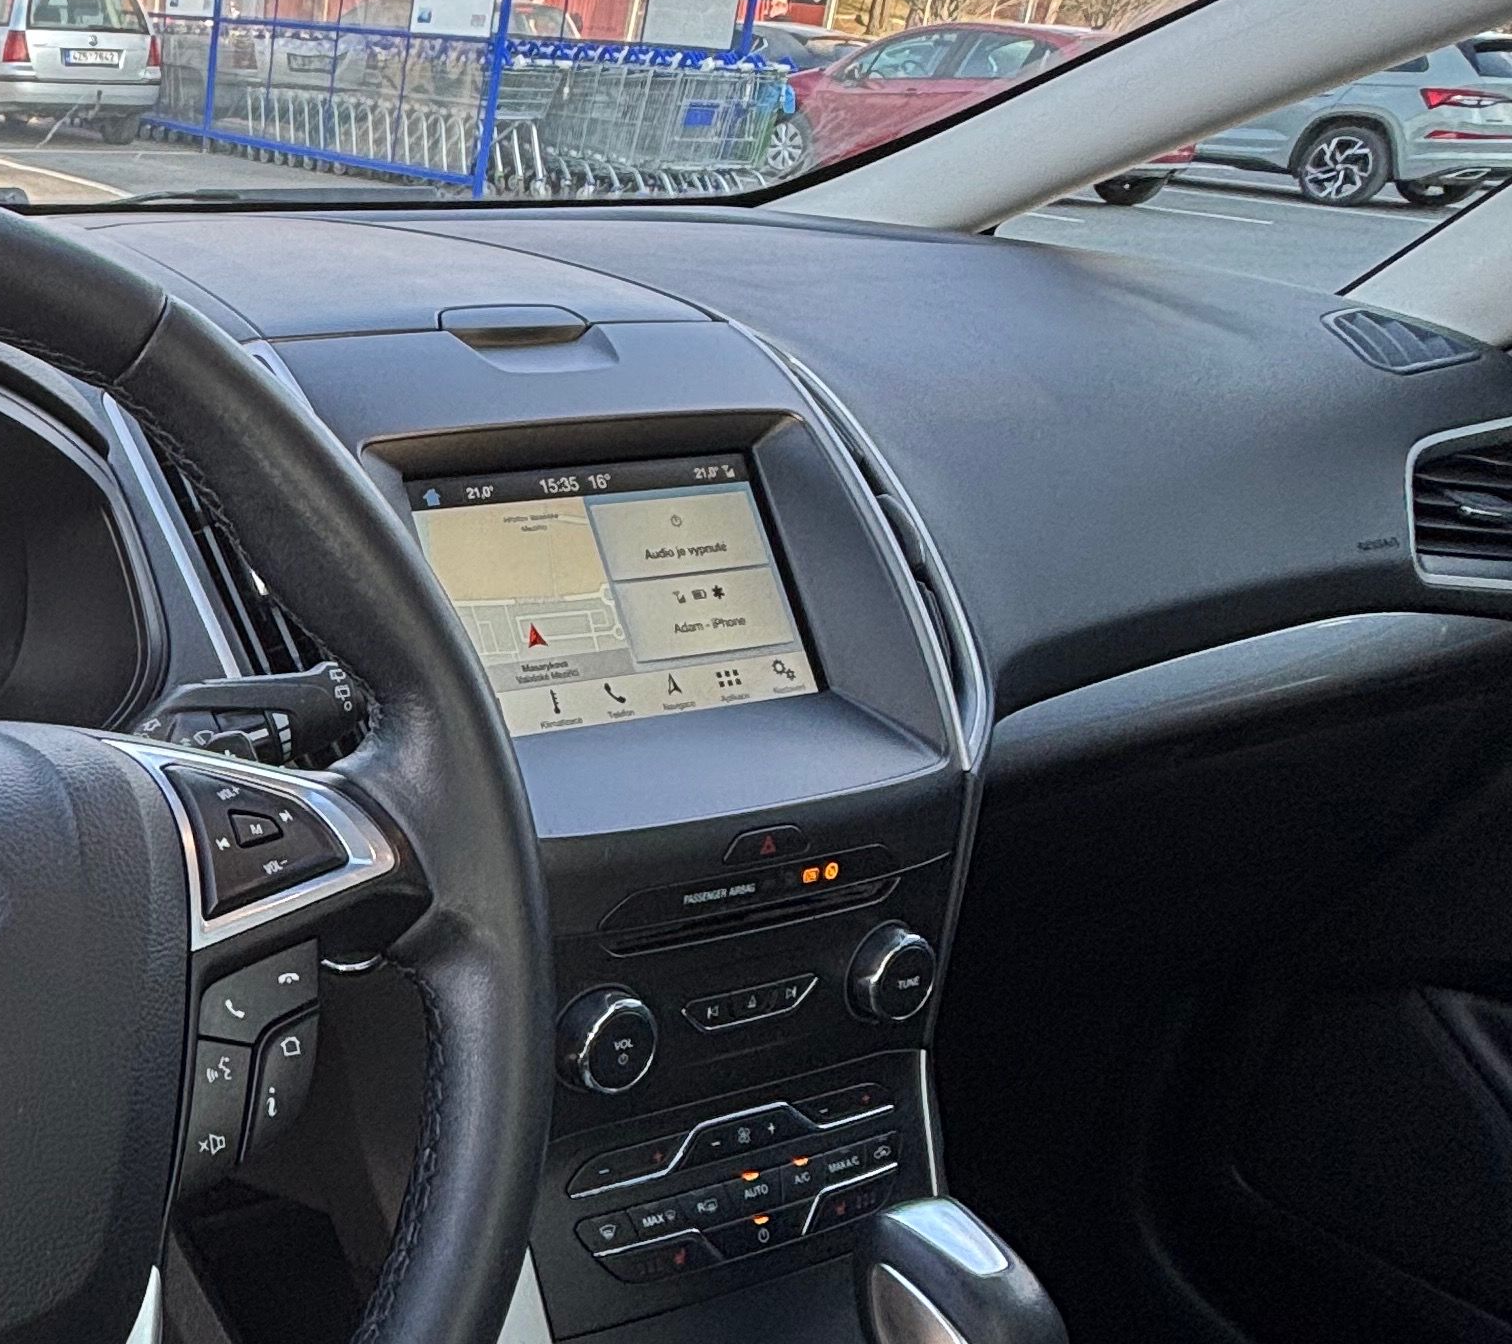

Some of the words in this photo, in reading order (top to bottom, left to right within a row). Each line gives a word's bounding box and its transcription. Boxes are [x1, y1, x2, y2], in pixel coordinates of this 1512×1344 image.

[539, 476, 579, 494] 15:35
[588, 473, 611, 490] 16°
[645, 547, 675, 560] Audio
[683, 888, 728, 905] PASSENGER
[729, 882, 756, 897] AIRBAG
[897, 974, 921, 990] TUNE
[613, 1036, 634, 1051] VOL
[744, 1183, 769, 1200] AUTO
[642, 1214, 665, 1228] MAX
